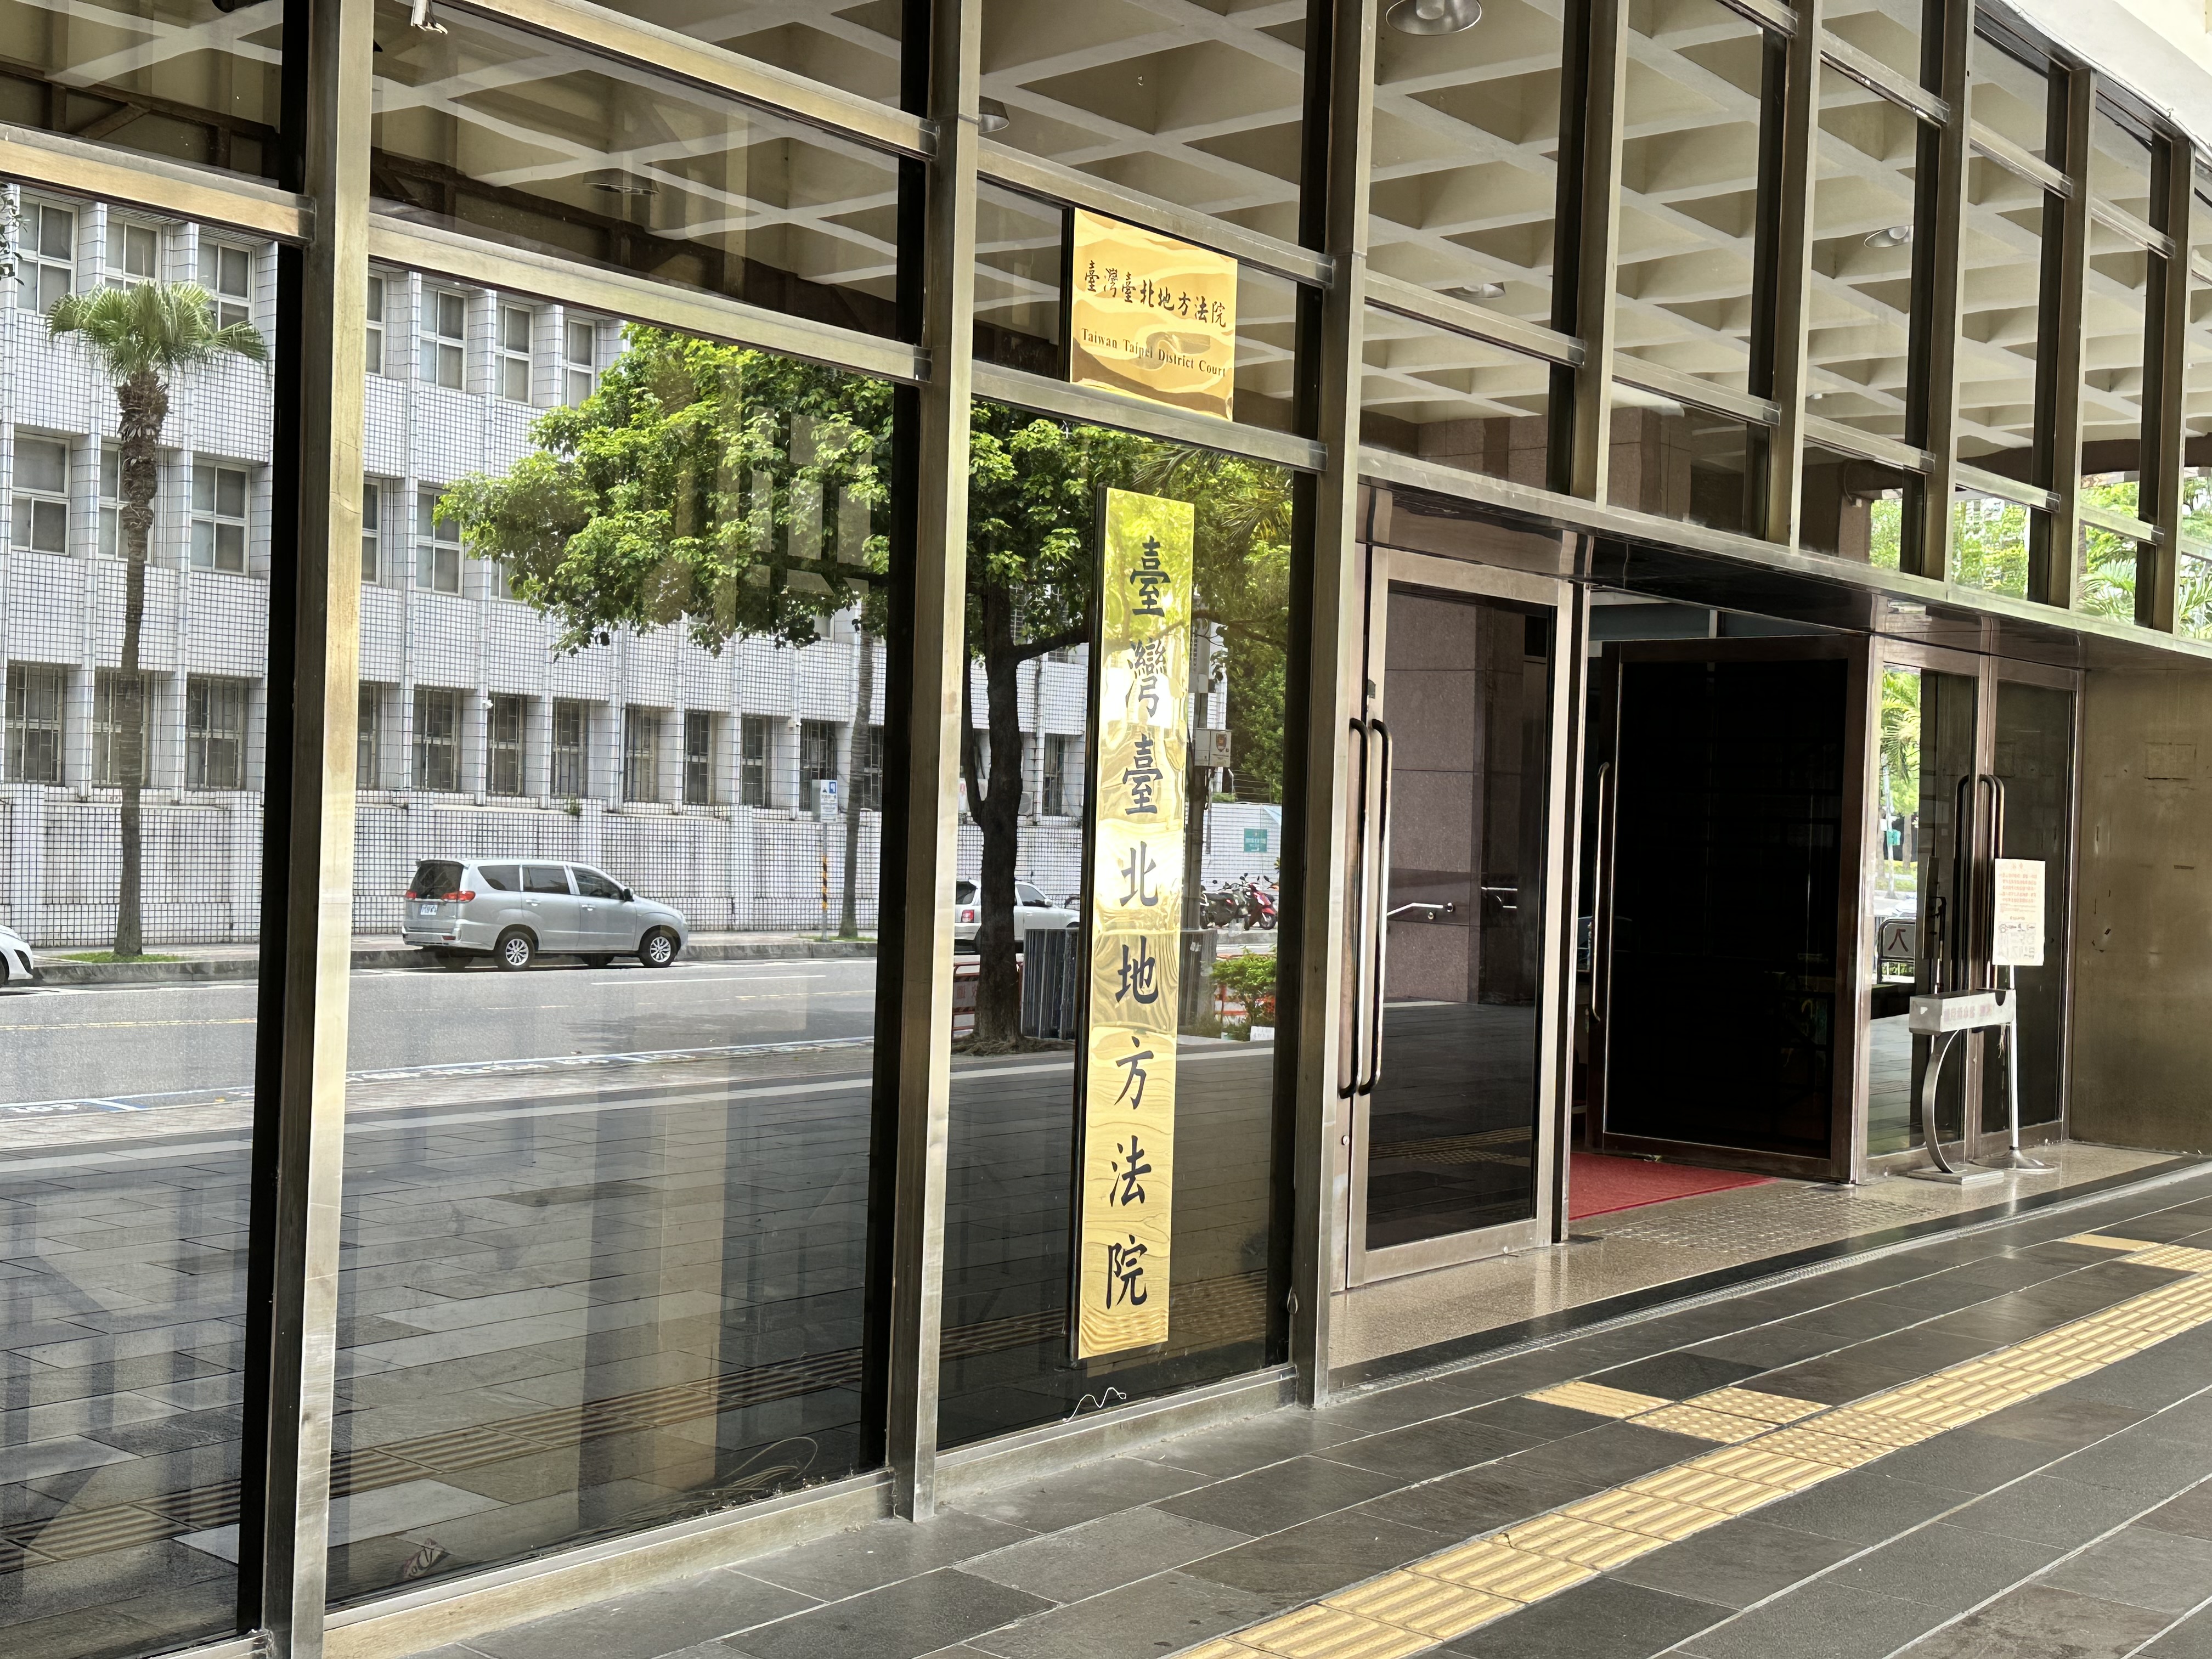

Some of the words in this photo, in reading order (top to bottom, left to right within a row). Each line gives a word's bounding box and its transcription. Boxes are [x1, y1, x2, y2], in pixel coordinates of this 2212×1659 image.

[1085, 260, 1226, 328] 臺灣臺北地方法院
[1081, 328, 1118, 349] Taiwan
[1123, 338, 1153, 359] Taipei
[1158, 348, 1194, 369] District
[1199, 360, 1225, 377] Court
[1106, 535, 1171, 1310] 臺灣臺北地方法院
